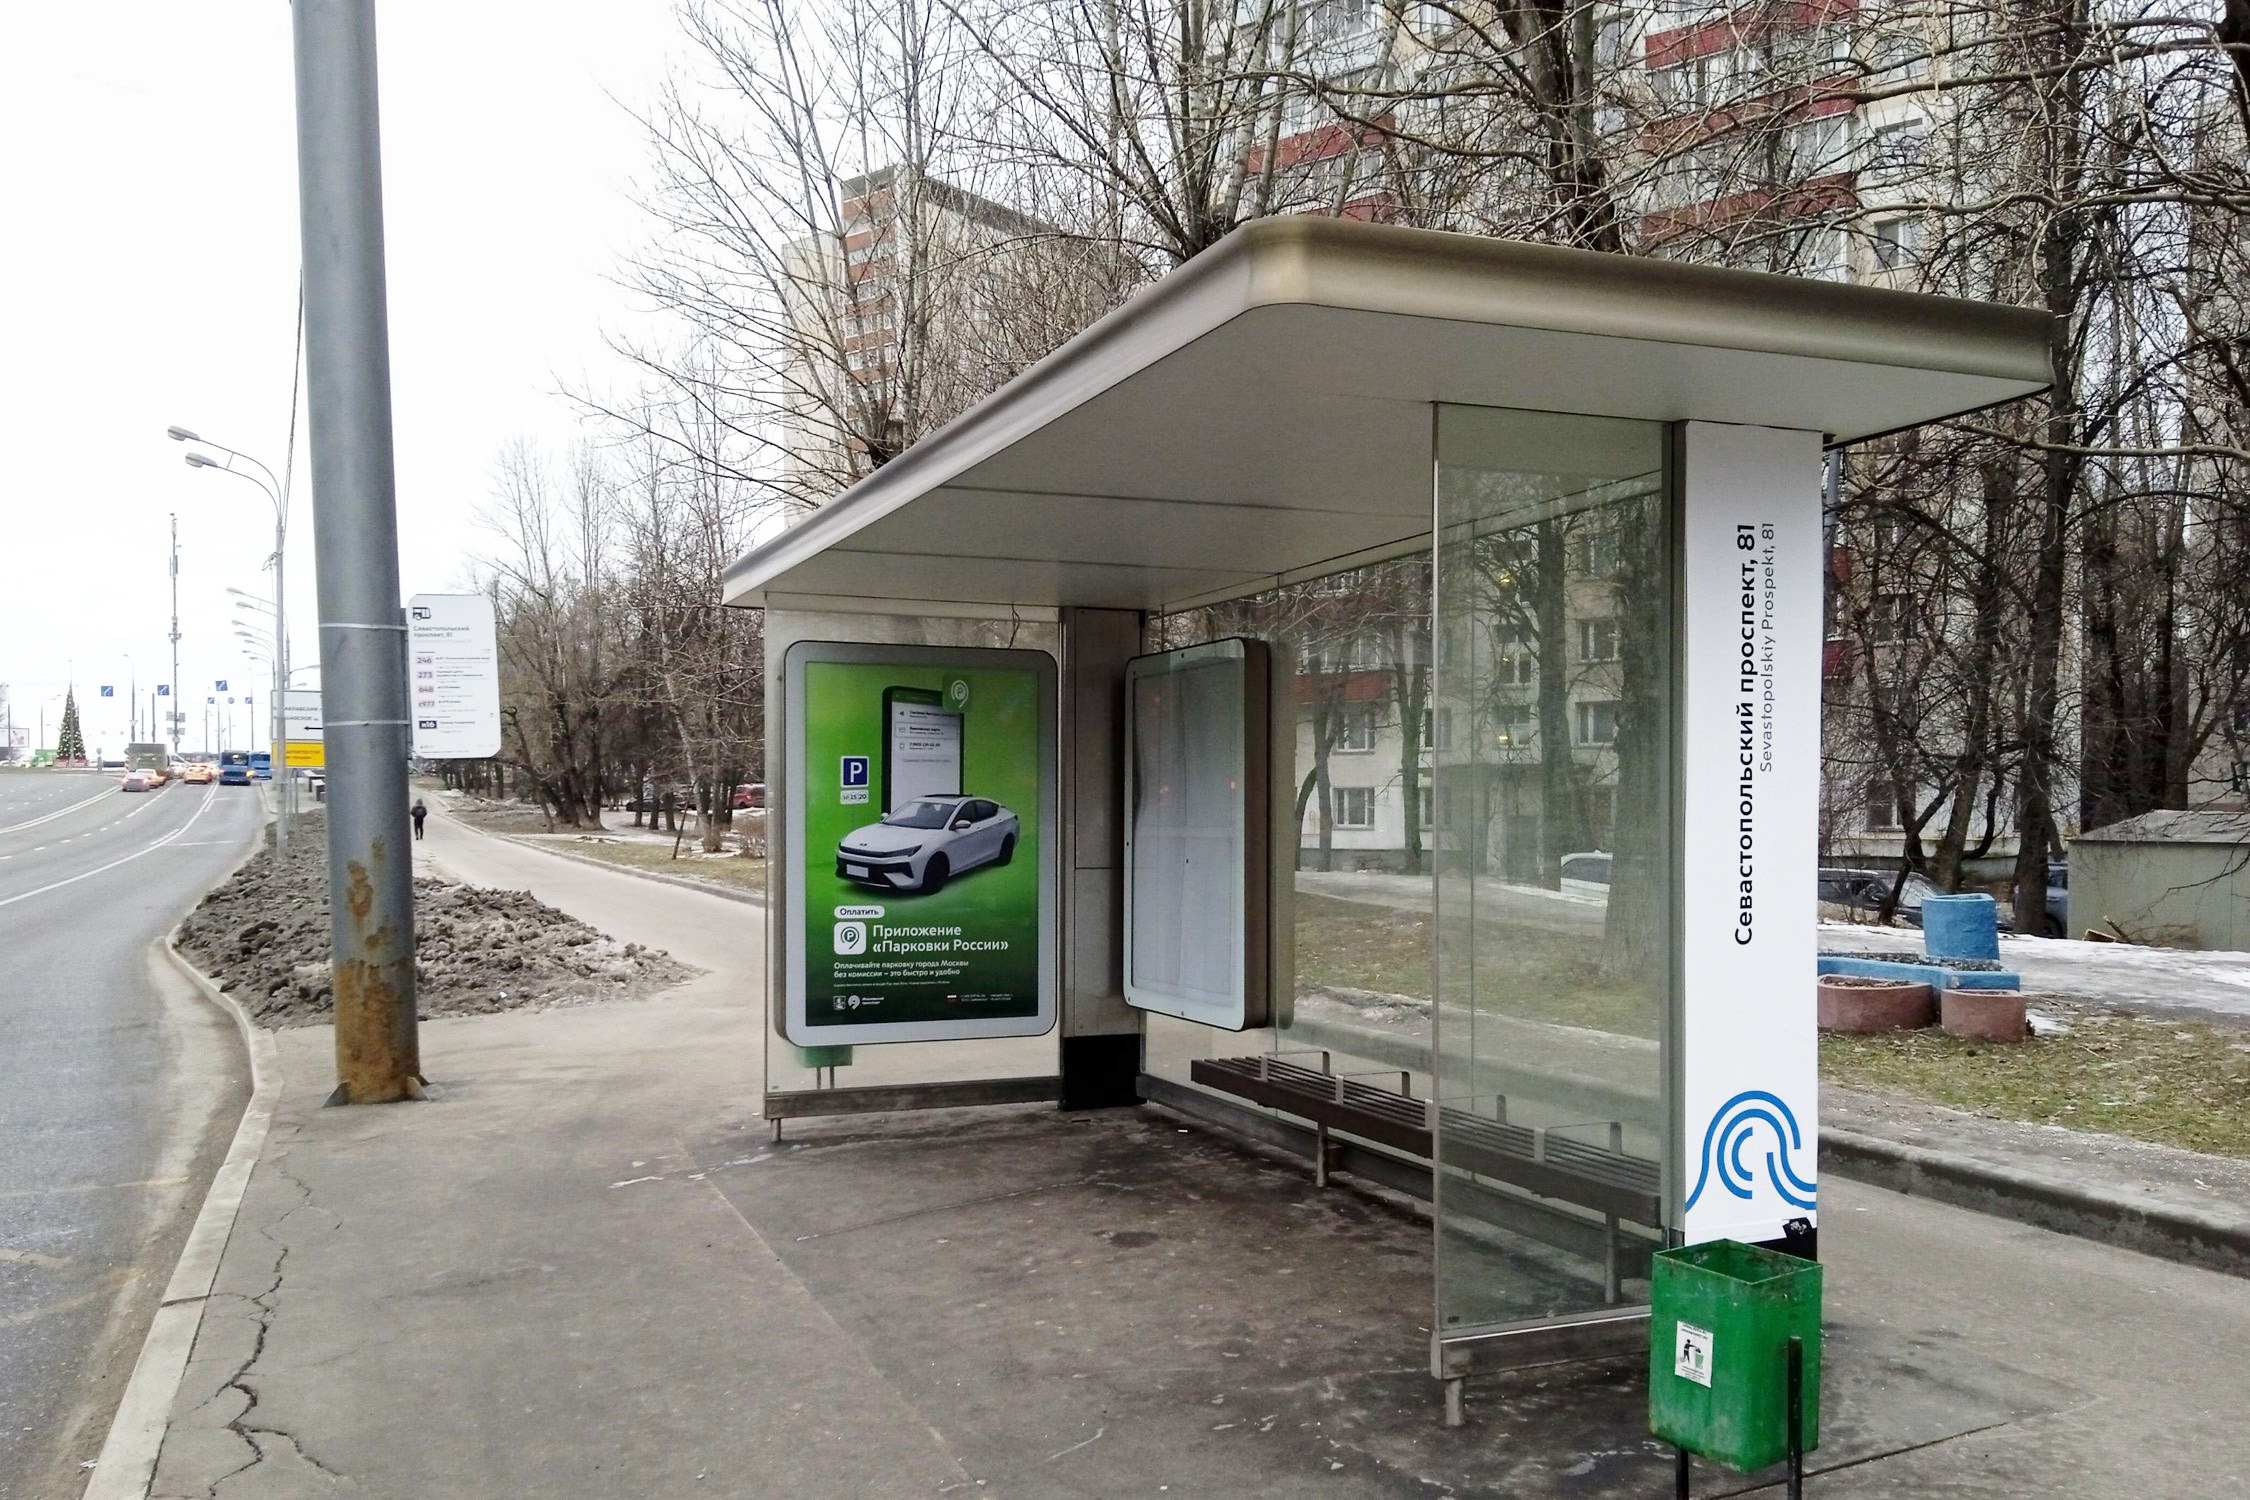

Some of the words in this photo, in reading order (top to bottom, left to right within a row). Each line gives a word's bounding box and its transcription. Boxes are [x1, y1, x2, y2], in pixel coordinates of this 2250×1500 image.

[1737, 524, 1755, 551] 81
[1762, 523, 1774, 541] 81
[1761, 545, 1776, 630] Prospekt,
[1740, 559, 1758, 693] проспект,
[1760, 636, 1776, 772] Sevastopolskiy
[850, 762, 863, 783] P
[1734, 702, 1753, 946] Севастопольский
[840, 908, 879, 916] Оплатить
[873, 925, 962, 939] Приложение
[873, 940, 950, 955] «Парковки
[953, 939, 1009, 951] России»
[834, 961, 880, 970] Оплачивайте
[882, 961, 914, 970] парковку
[915, 961, 939, 969] города
[834, 969, 847, 978] без
[848, 970, 883, 978] комиссии
[902, 968, 929, 978] быстро
[935, 968, 960, 977] удобно
